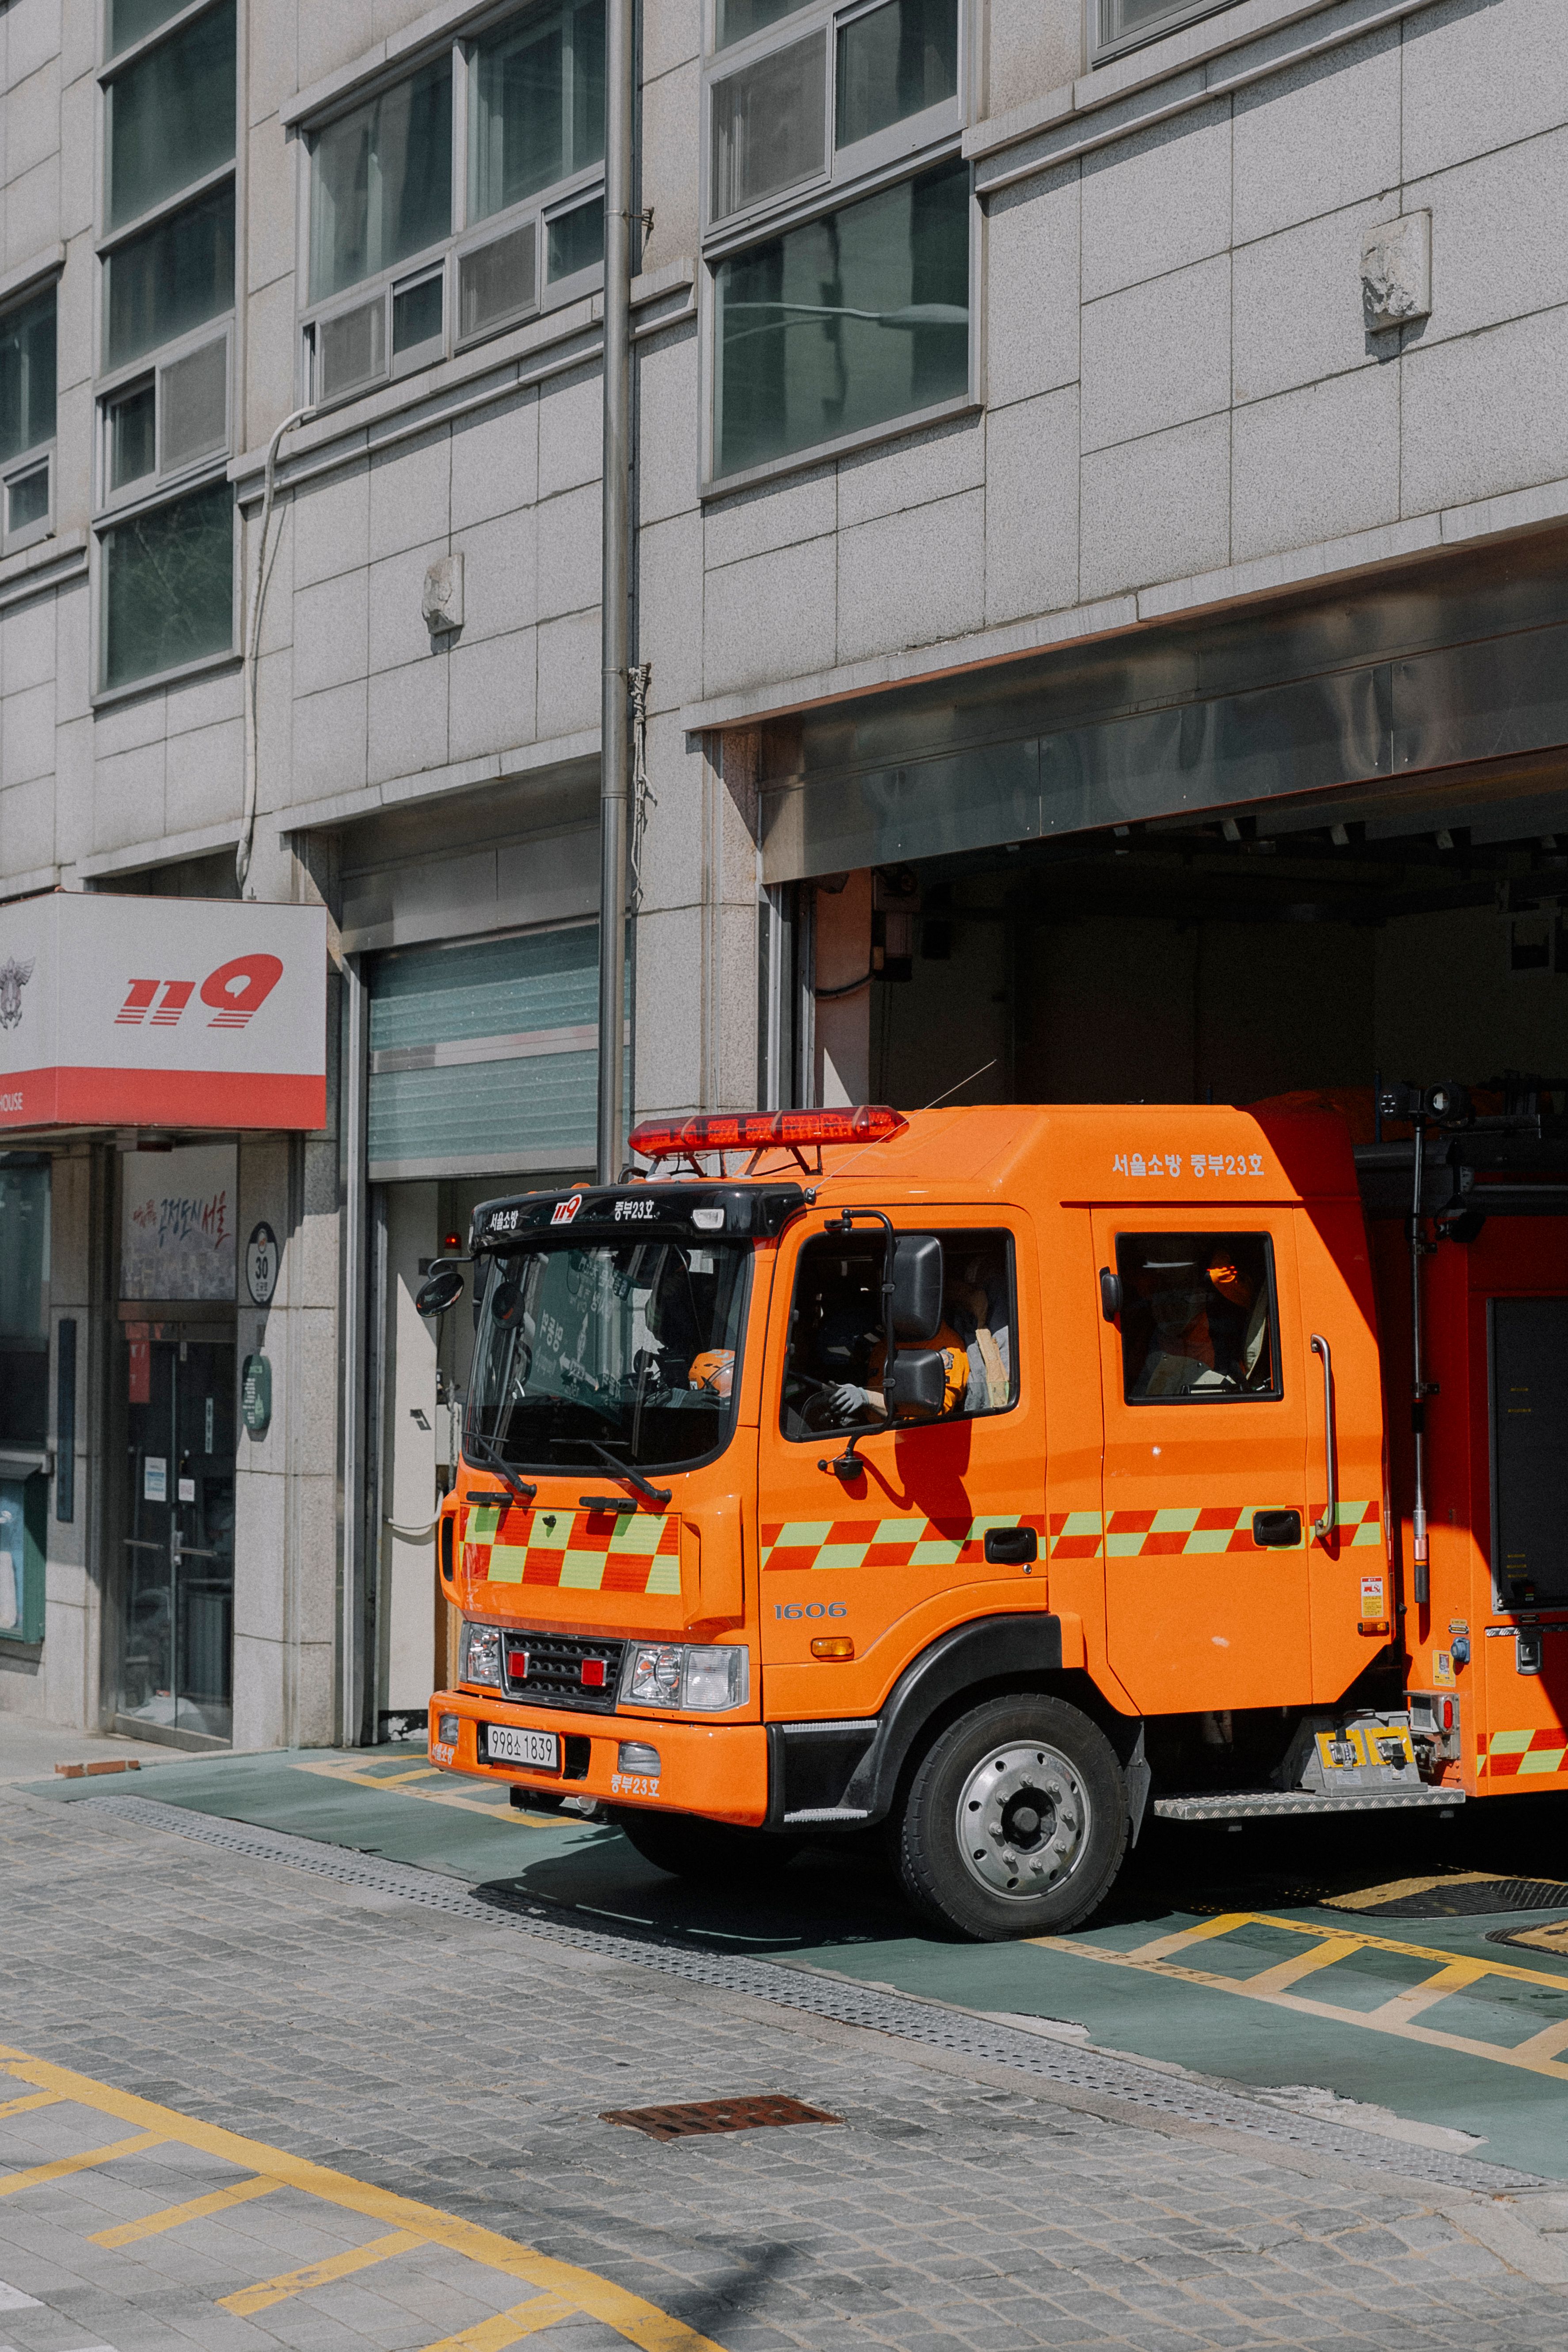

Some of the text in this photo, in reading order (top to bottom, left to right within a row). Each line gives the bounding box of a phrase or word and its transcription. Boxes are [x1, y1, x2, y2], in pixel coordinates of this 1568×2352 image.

[114, 953, 283, 1028] 119
[1112, 1153, 1265, 1178] 서울소방 중부23호
[490, 1210, 519, 1231] 서울소방
[552, 1195, 581, 1224] 119
[614, 1199, 655, 1221] 중부23호
[255, 1256, 268, 1280] 30
[773, 1601, 848, 1620] 1606
[432, 1743, 454, 1765] 서울소방
[524, 1735, 552, 1762] 1839
[611, 1774, 660, 1797] 중부23호
